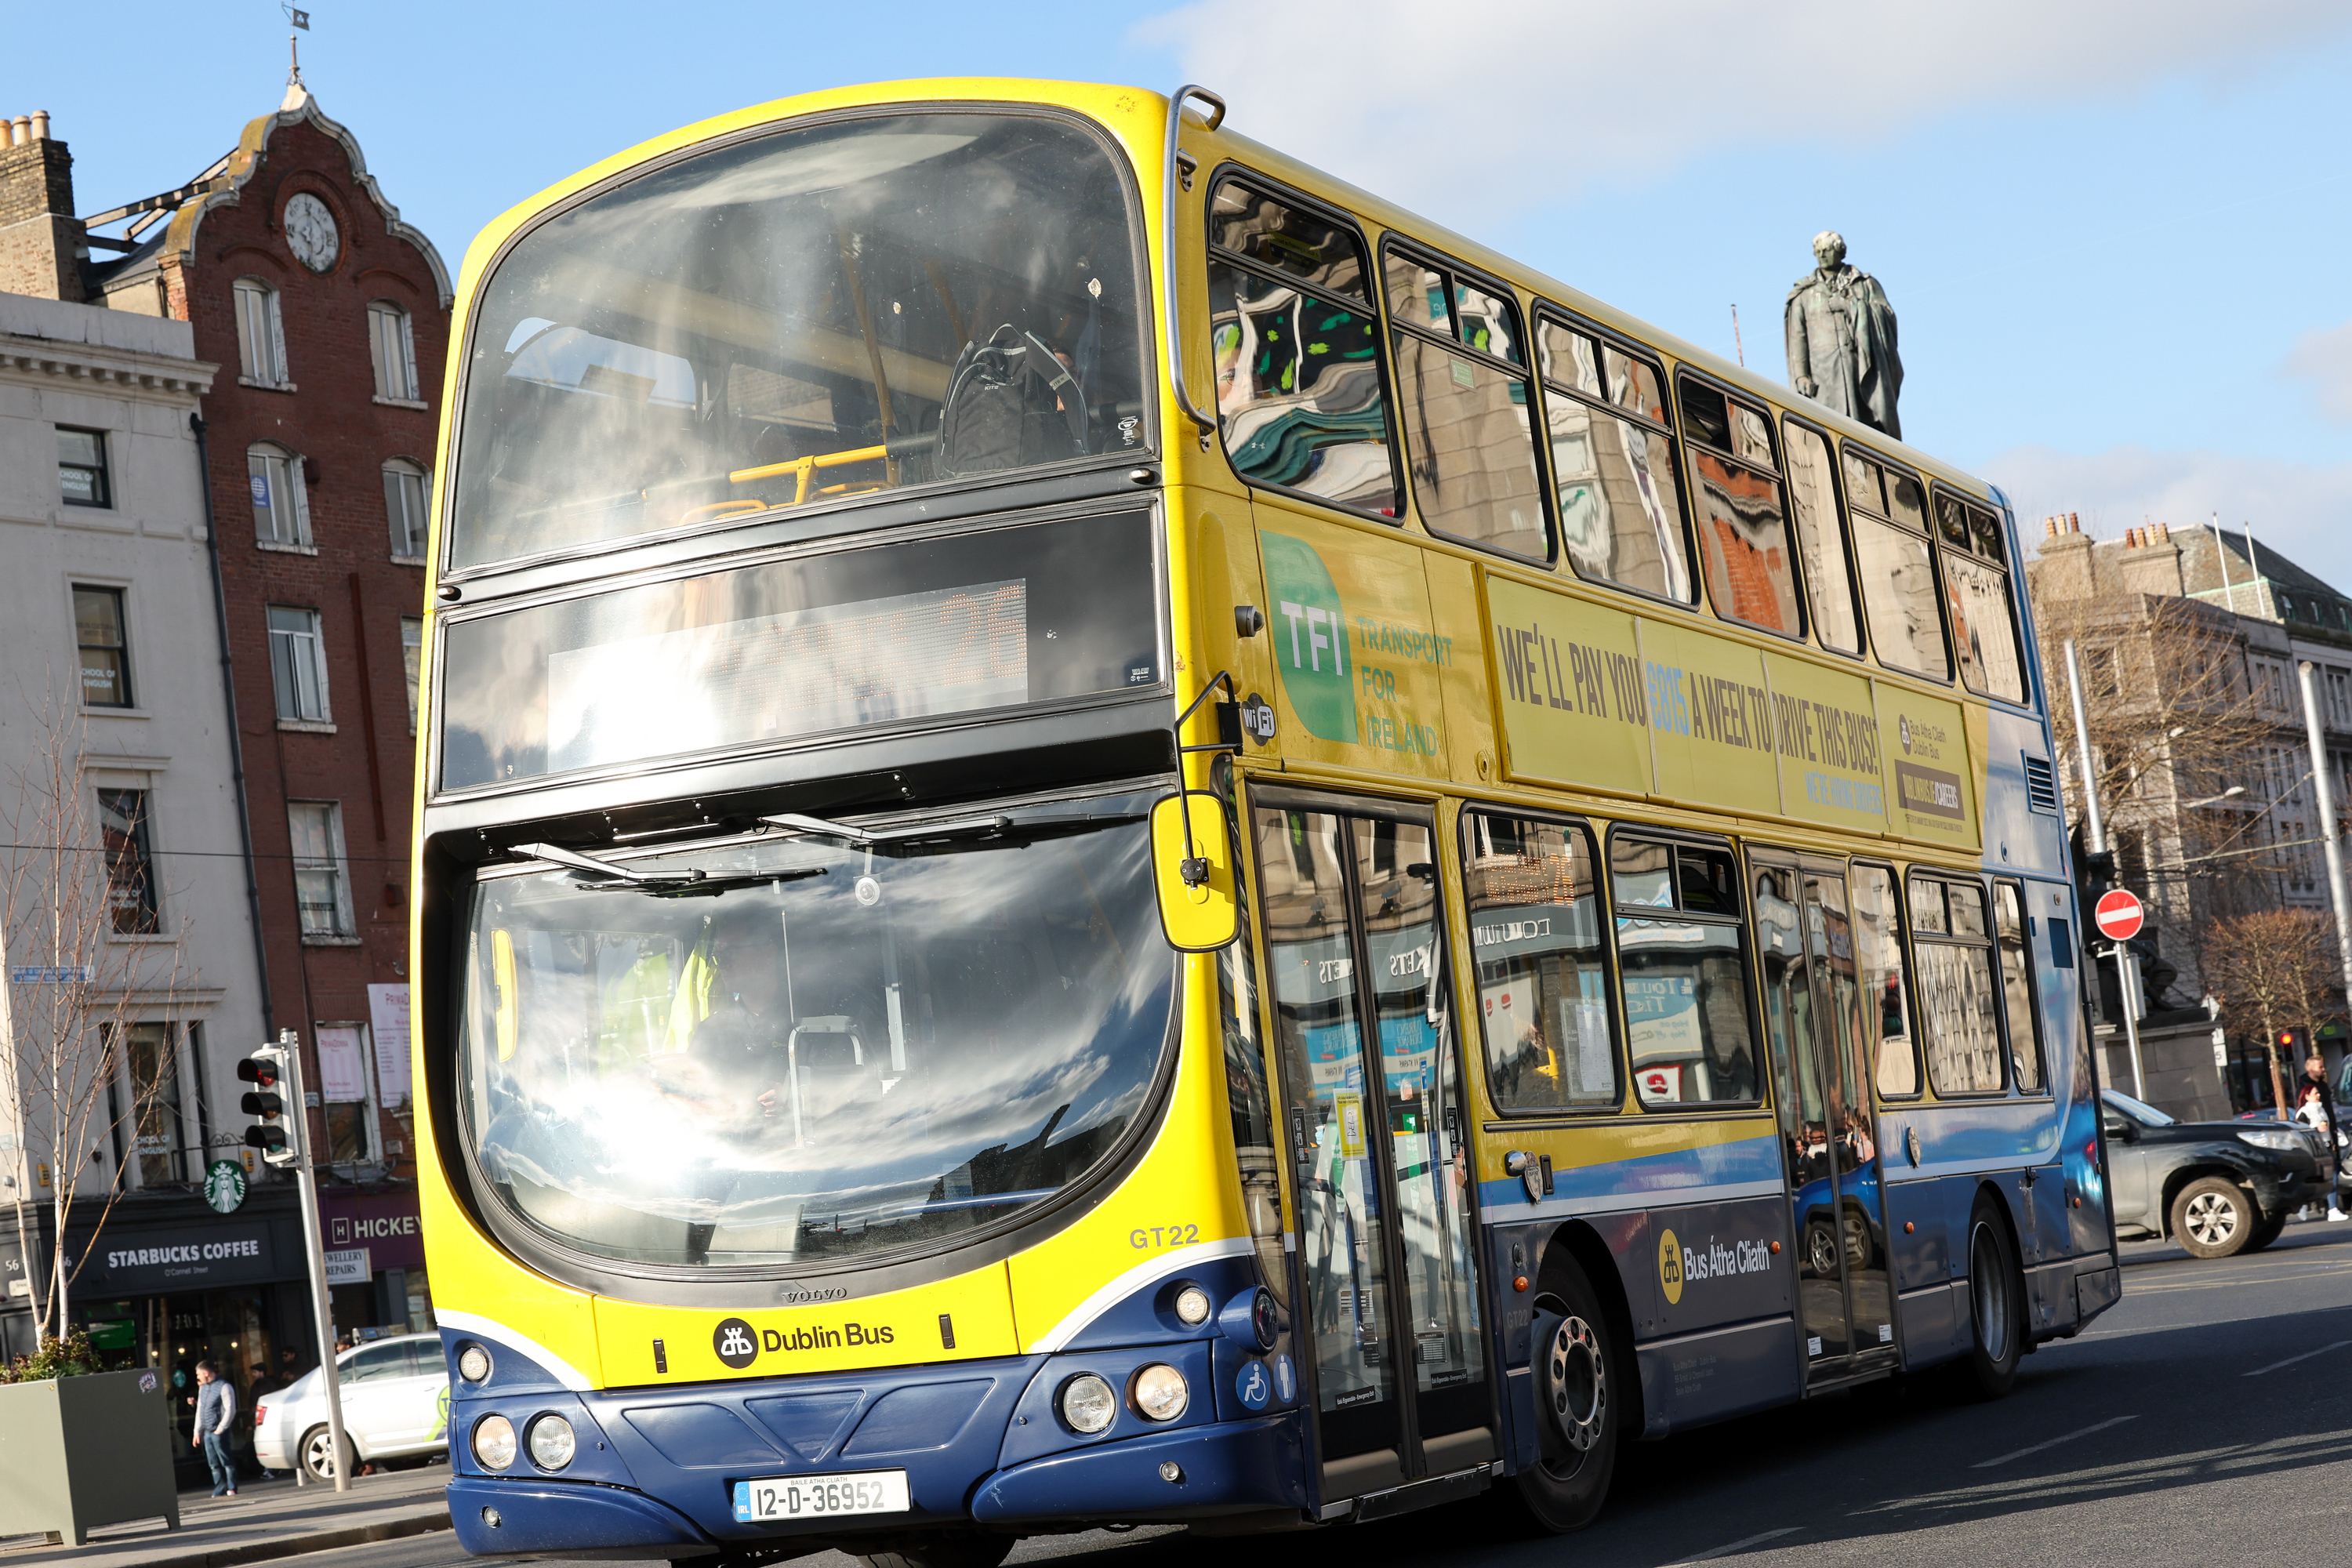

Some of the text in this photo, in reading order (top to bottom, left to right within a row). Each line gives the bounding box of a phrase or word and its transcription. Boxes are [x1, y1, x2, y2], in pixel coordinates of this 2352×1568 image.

[60, 470, 82, 481] CHOOL
[1280, 601, 1343, 676] TFI
[1356, 615, 1452, 667] TRANSPORT
[82, 668, 105, 677] CHOOL
[1361, 666, 1397, 702] FOR
[1497, 622, 1573, 712] WE'LL
[1568, 642, 1607, 718] PAY
[1605, 651, 1646, 727] YOU
[1690, 672, 1705, 739] A
[1700, 674, 1752, 749] WEEK
[1748, 686, 1772, 753] TO
[1772, 691, 1817, 762] DRIVE
[1813, 702, 1847, 769] THIS
[1366, 715, 1437, 757] IRELAND
[1912, 739, 1940, 760] Dublin Bus
[385, 993, 410, 1006] PRIMAD
[136, 1135, 160, 1145] CHOOL
[1130, 1224, 1200, 1250] GT22
[5, 1258, 20, 1272] 56
[108, 1240, 260, 1269] STARBUCKS COFFEE
[1683, 1235, 1770, 1281] Bus Átha Cliath
[326, 1264, 357, 1276] REPAIRS
[782, 1287, 848, 1303] VOLVO
[1507, 1308, 1528, 1329] GT22
[762, 1323, 895, 1352] Dublin Bus
[737, 1504, 750, 1514] IRL
[757, 1481, 884, 1516] 12-D-36952
